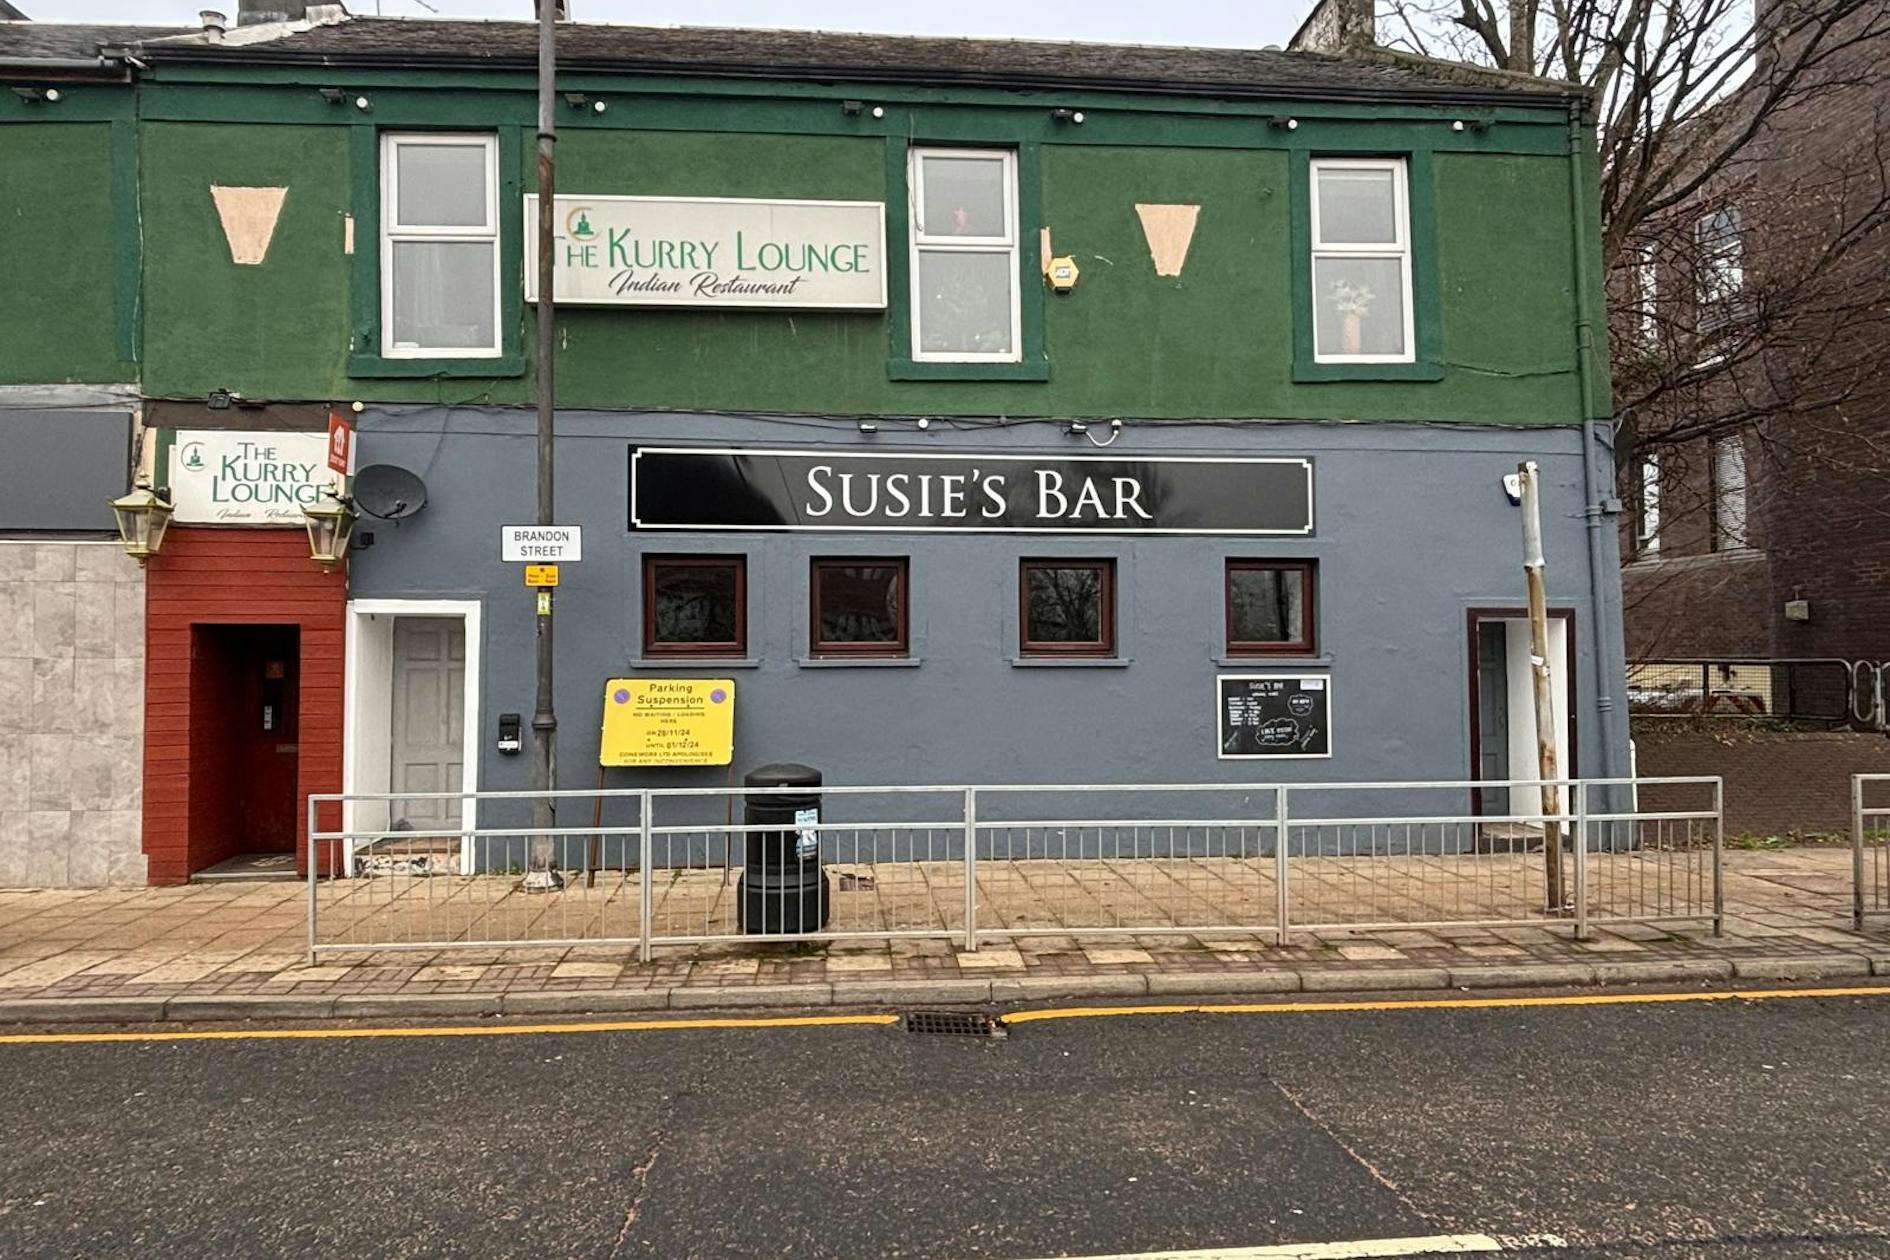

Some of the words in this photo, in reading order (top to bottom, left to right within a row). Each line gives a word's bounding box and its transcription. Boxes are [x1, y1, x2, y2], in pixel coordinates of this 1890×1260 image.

[608, 227, 719, 269] KURRY
[736, 230, 871, 273] LOUNGE
[608, 270, 681, 296] Indian
[690, 271, 804, 298] Restaurant
[237, 442, 277, 461] THE
[221, 454, 317, 482] KURRY
[805, 465, 1007, 518] SUSIE'S
[1033, 469, 1153, 519] BAR
[514, 531, 569, 541] BRANDON
[520, 545, 563, 556] STREET
[649, 683, 693, 694] Parking
[637, 695, 704, 705] Suspension
